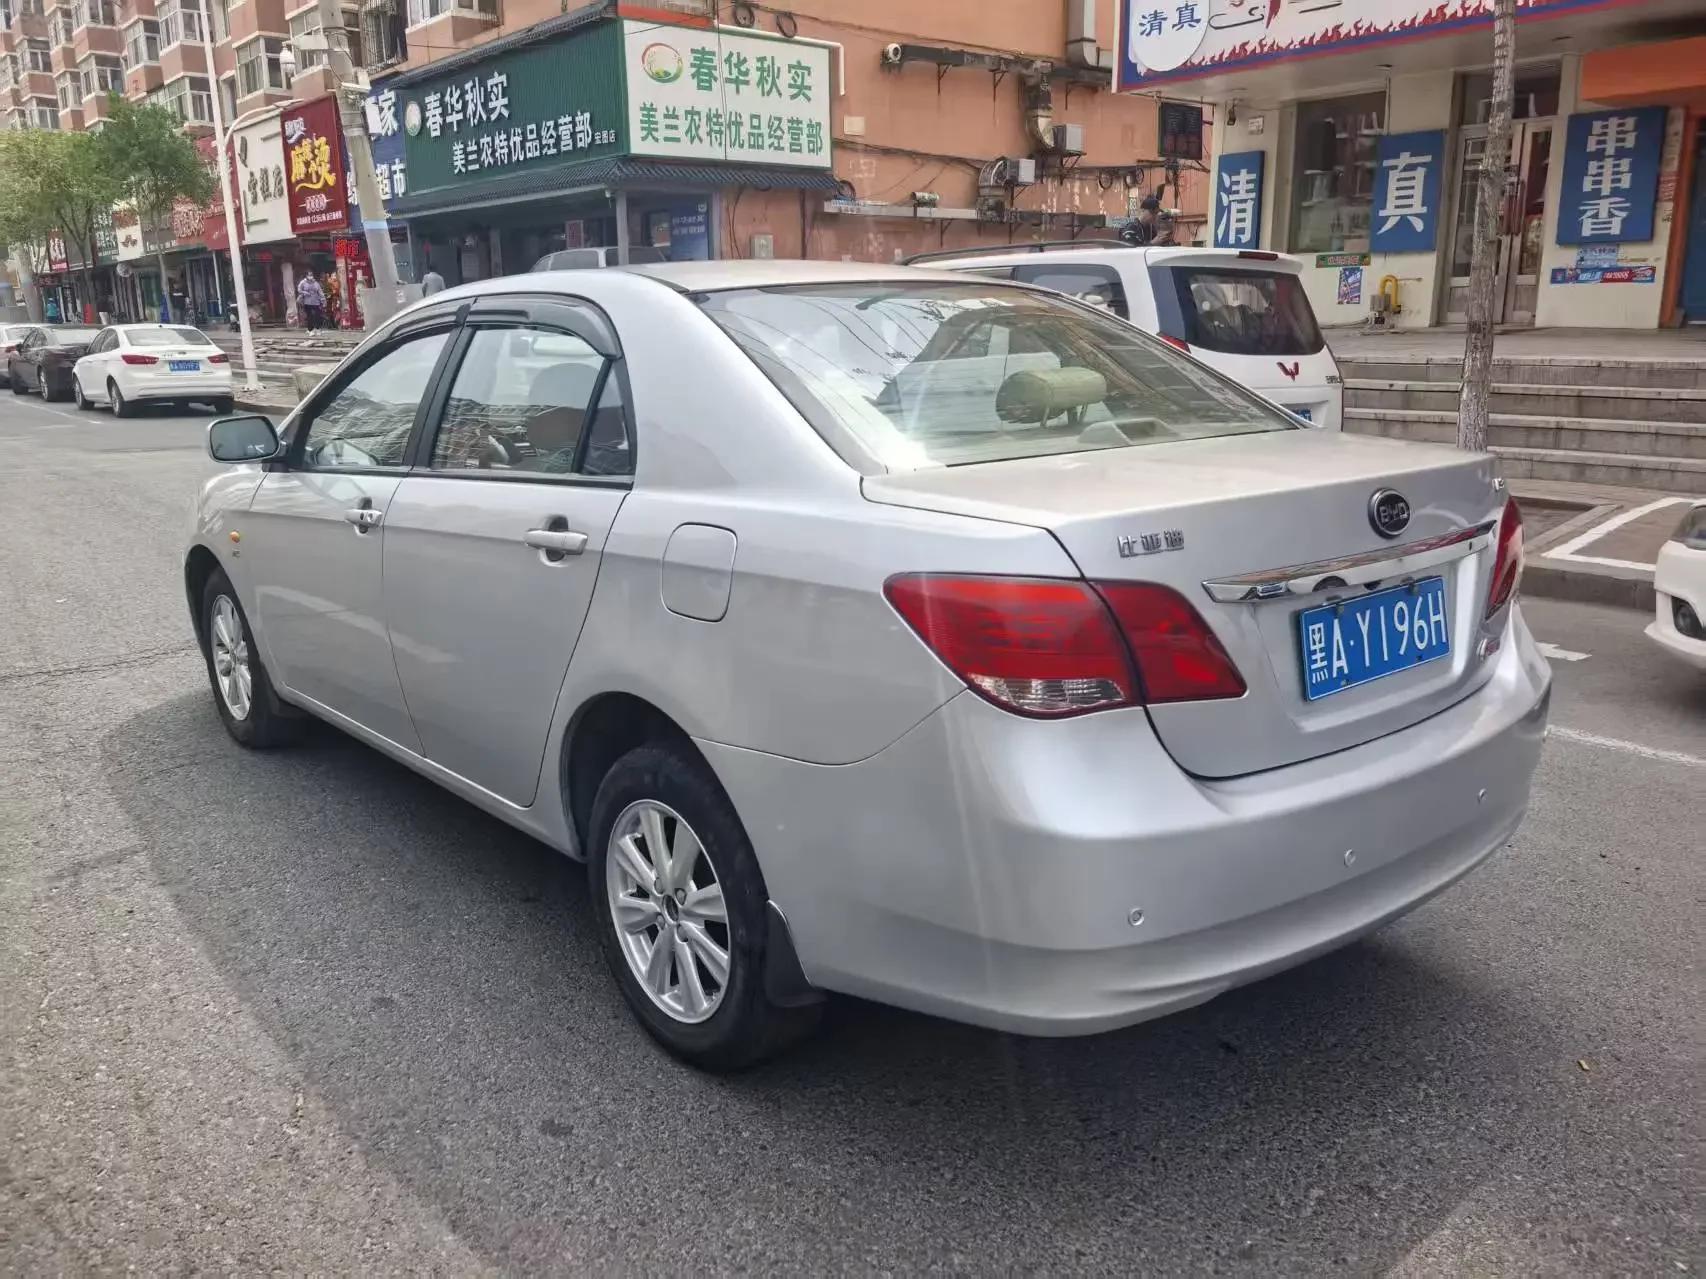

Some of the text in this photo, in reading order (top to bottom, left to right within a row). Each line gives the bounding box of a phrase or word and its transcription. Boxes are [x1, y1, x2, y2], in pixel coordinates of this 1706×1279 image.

[1138, 3, 1202, 38] 清真
[424, 71, 510, 138] 春华秋实
[689, 46, 813, 103] 春华秋实
[452, 110, 592, 175] 美兰农特优品经营部
[639, 101, 825, 156] 美兰农特优品经营部
[1216, 168, 1257, 245] 清
[1376, 151, 1433, 236] 真
[1578, 116, 1640, 237] 串串香
[1116, 528, 1185, 558] 比亚迪
[1378, 500, 1411, 525] BYD
[1308, 590, 1448, 685] 黑A·Y196H
